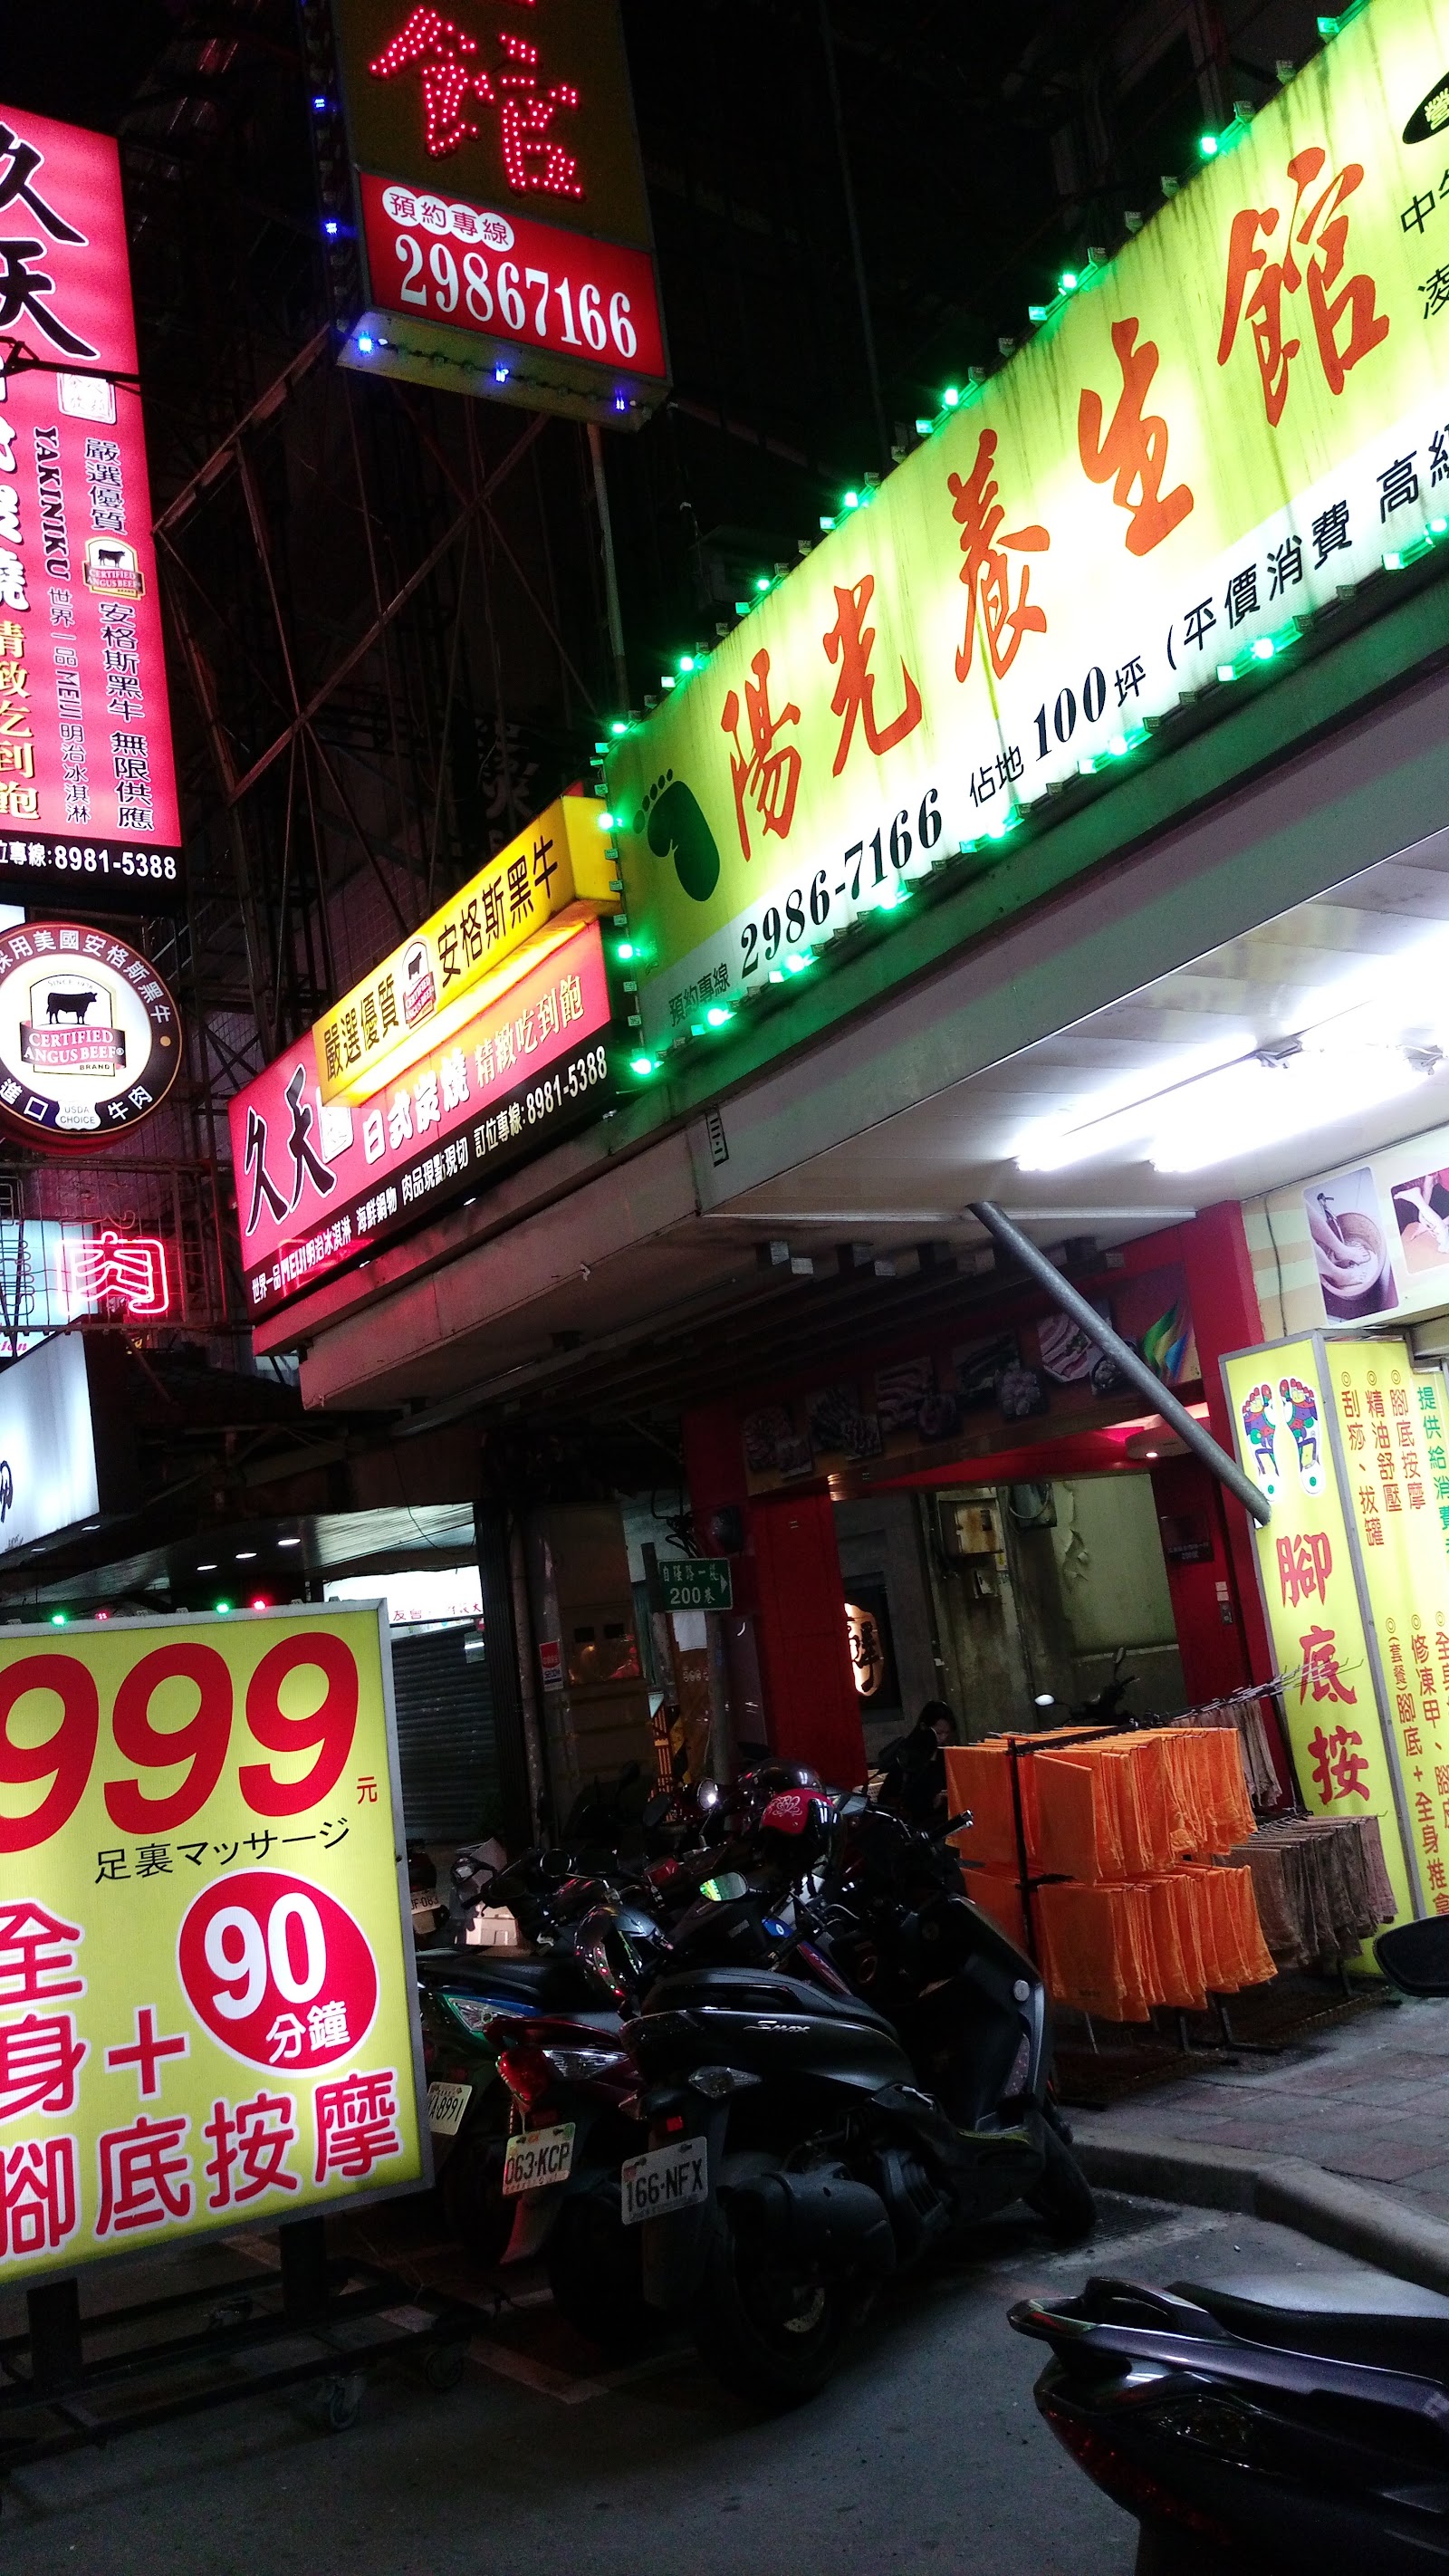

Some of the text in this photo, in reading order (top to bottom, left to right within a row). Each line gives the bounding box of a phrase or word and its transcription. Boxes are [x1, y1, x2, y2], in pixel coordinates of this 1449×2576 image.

[389, 192, 509, 245] 預約專線
[395, 234, 637, 359] 29867166
[34, 427, 71, 581] YAKINIKU
[85, 438, 128, 535] 嚴選優質
[722, 148, 1389, 861] 陽光養生館
[99, 601, 145, 724] 安格斯黑牛
[110, 731, 155, 831] 無限供應
[668, 963, 731, 1027] 預約專線
[741, 788, 943, 978] 2986-7166
[323, 834, 559, 1082] 嚴選優質 安格斯黑牛
[24, 1046, 79, 1064] ANGUS
[28, 1030, 114, 1047] CERTIFIED
[474, 975, 584, 1089] 精緻吃到飽
[60, 1115, 96, 1125] CHOICE
[64, 1105, 91, 1114] USDA
[107, 1085, 154, 1121] 牛肉
[356, 1187, 398, 1235] 海鮮鍋物
[401, 1136, 469, 1206] 肉品現點現切
[55, 1230, 170, 1319] 肉
[1365, 1389, 1403, 1513] 精油舒壓
[1389, 1389, 1426, 1511] 腳底按摩
[356, 1775, 378, 1804] 元
[94, 1816, 350, 1884] 足裏マッサージ
[204, 1892, 328, 2020] 90
[265, 2000, 352, 2064] 分鐘
